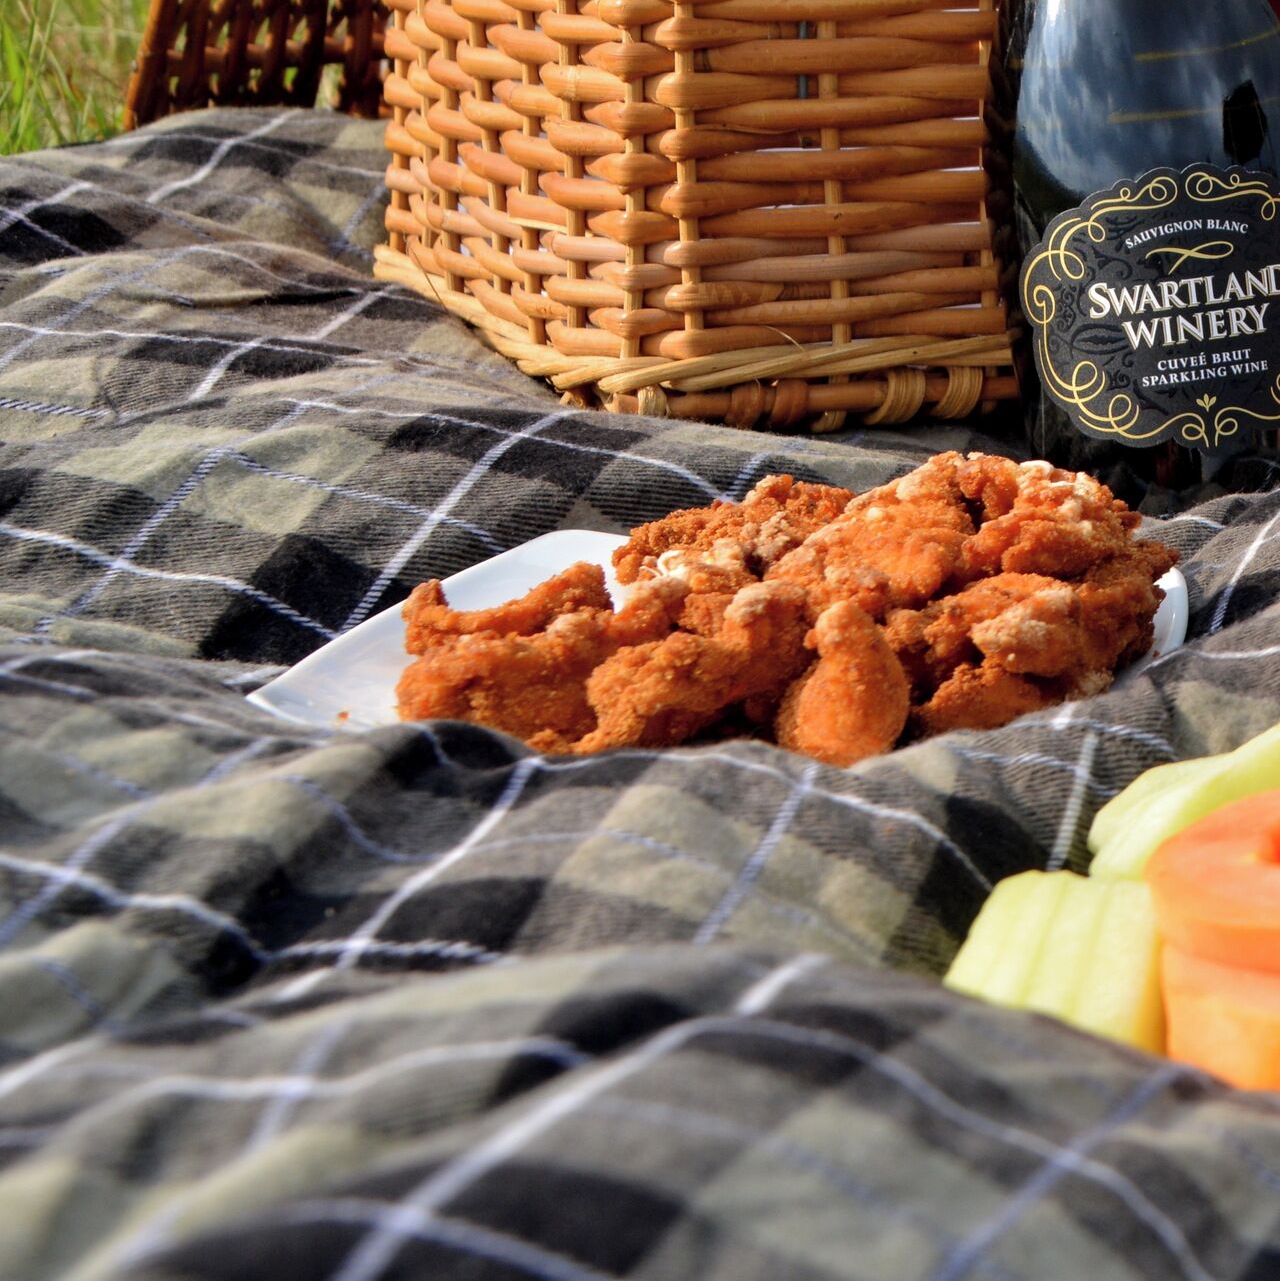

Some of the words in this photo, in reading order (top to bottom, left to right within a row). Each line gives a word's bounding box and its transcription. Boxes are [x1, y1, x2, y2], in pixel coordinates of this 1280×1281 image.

[1125, 220, 1202, 248] SAUVIGNON
[1206, 219, 1248, 235] BLANC
[1122, 302, 1271, 350] WINERY
[1142, 367, 1227, 387] SPARKLING
[1231, 360, 1268, 374] WINE
[1157, 352, 1206, 371] CUVEÉ
[1212, 349, 1251, 364] BRUT
